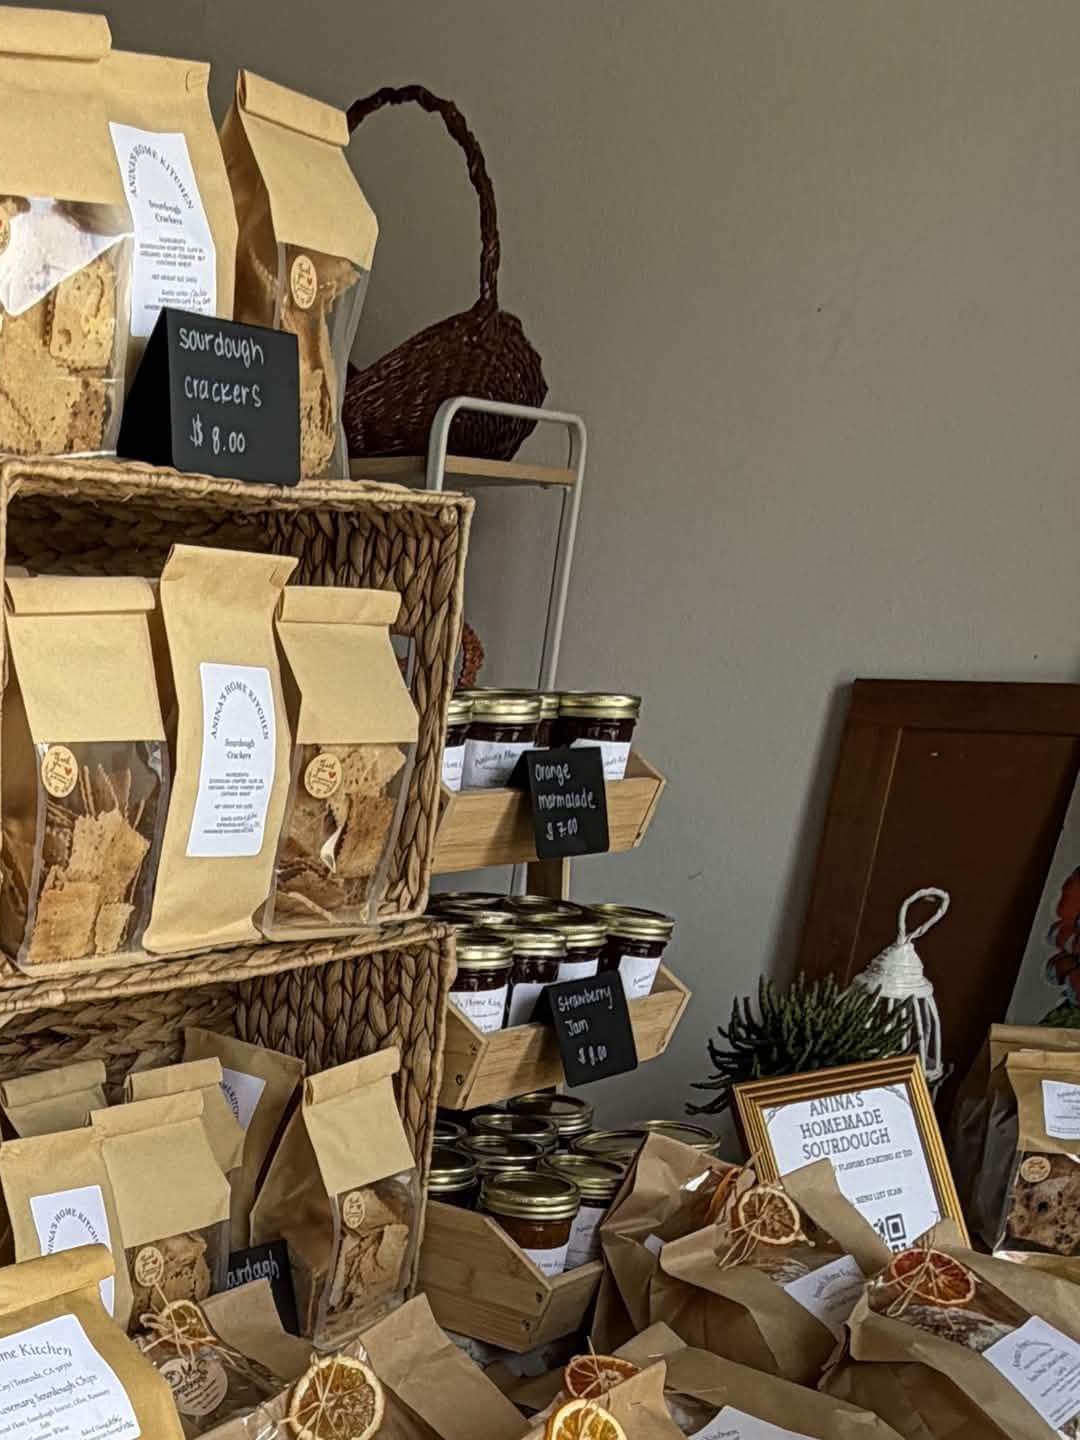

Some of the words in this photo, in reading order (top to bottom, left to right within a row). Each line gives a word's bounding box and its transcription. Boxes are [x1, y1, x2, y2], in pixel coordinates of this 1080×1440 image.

[184, 376, 263, 408] crackers
[800, 1108, 884, 1140] HOMEMADE
[802, 1126, 891, 1160] SOURDOUGH
[19, 1341, 73, 1358] Kitchen
